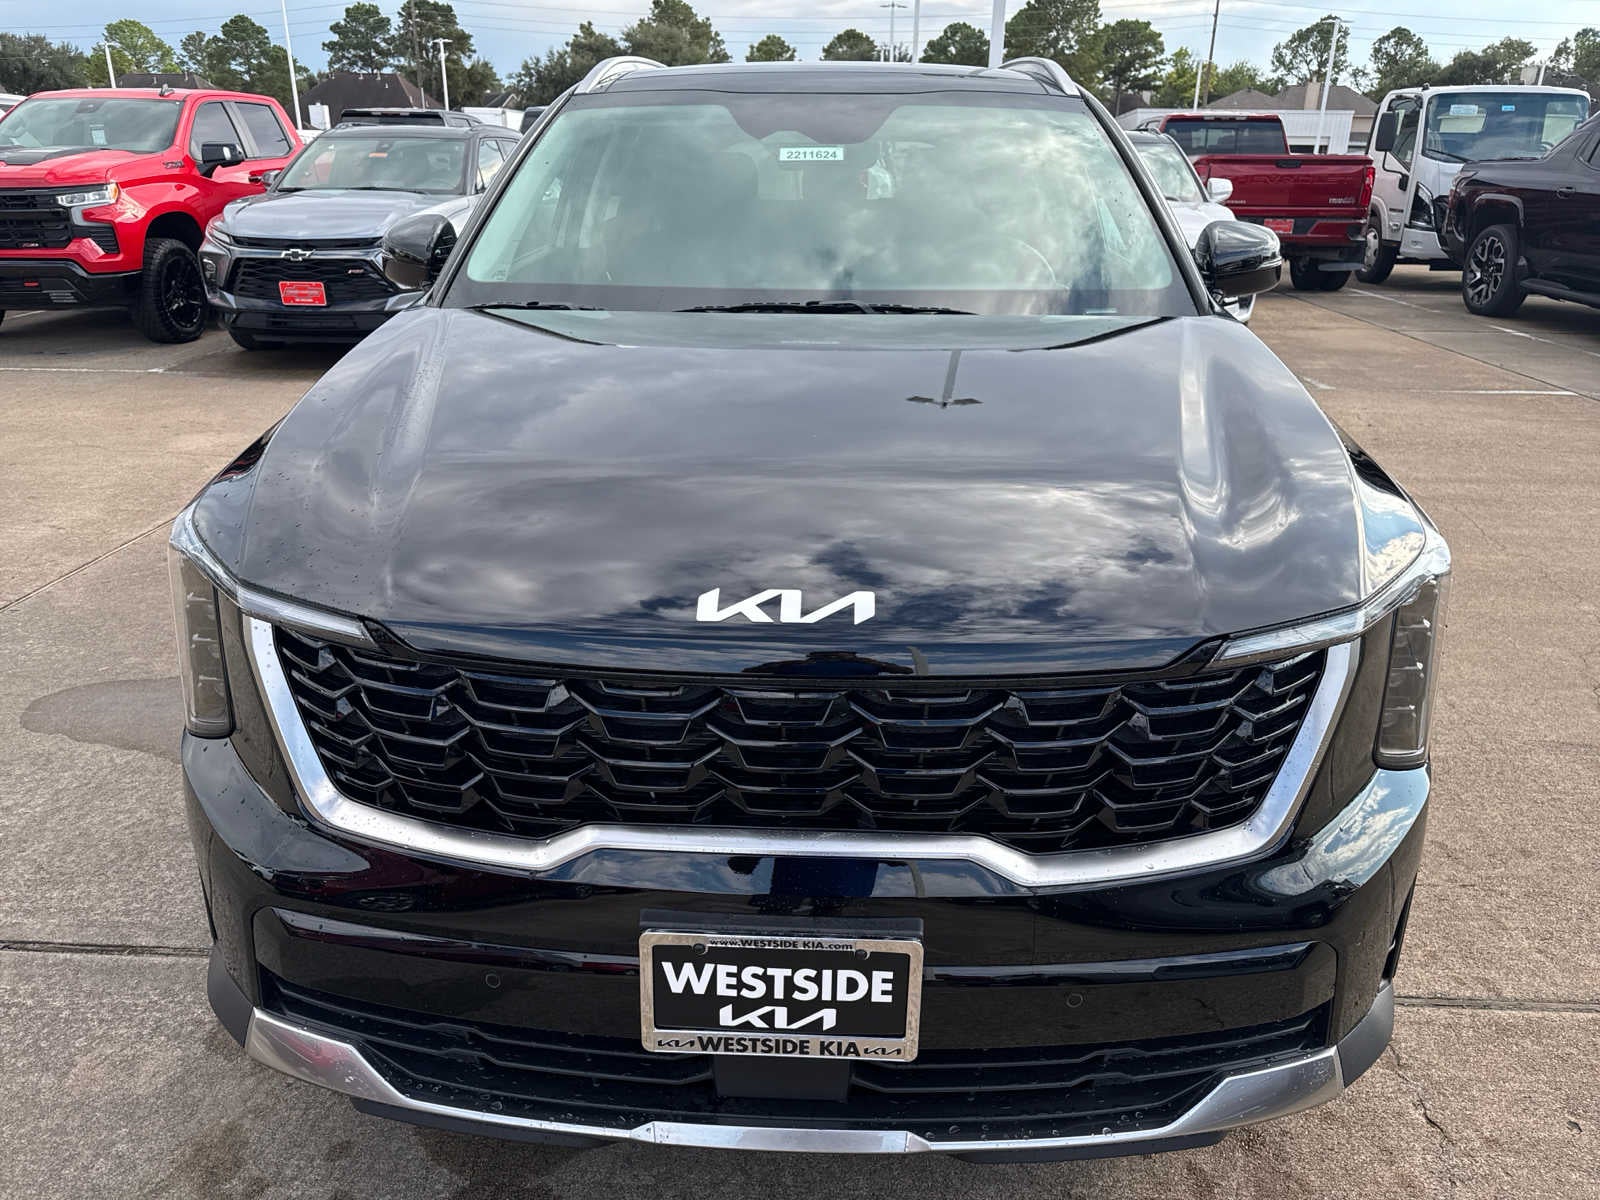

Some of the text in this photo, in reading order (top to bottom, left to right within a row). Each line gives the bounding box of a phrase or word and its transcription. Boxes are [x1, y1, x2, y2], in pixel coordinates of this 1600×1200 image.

[786, 150, 837, 160] 2211624
[695, 587, 876, 625] KIA
[802, 940, 853, 951] KIA.com
[661, 961, 894, 1003] WESTSIDE
[719, 1003, 837, 1031] KIA
[697, 1036, 810, 1055] WESTSIDE
[819, 1040, 861, 1057] KIA
